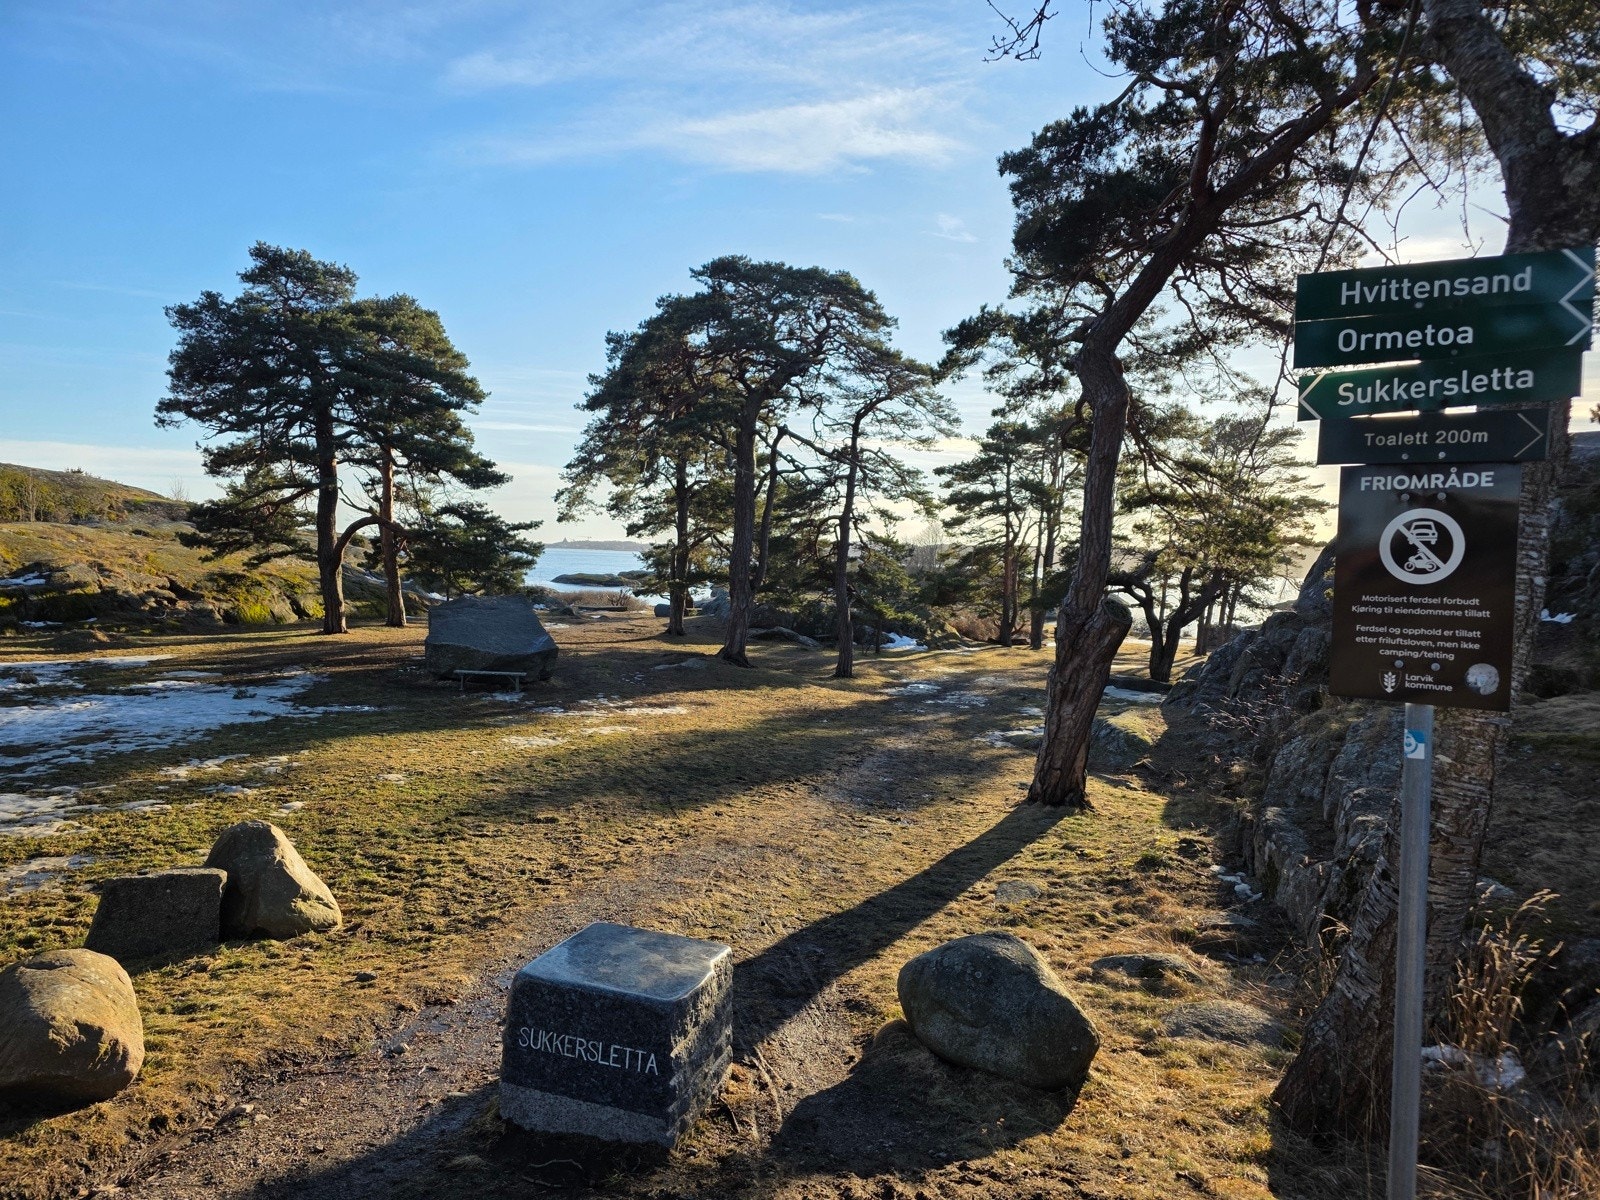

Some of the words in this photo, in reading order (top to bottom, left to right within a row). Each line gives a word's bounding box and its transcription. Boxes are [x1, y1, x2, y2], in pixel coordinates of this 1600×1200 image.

[1340, 266, 1532, 306] Hvittensand
[1337, 324, 1474, 352] Ormetoa
[1337, 367, 1535, 406] Sukkersletta
[1364, 431, 1428, 446] Toalett
[1435, 429, 1489, 444] 200m
[1360, 466, 1495, 491] FRIOMRÅDE
[1361, 595, 1408, 604] Motorisert
[1409, 596, 1441, 604] ferdsel
[1443, 596, 1480, 606] forbudt
[1351, 605, 1383, 615] Kjøring
[1384, 605, 1393, 614] til
[1394, 607, 1463, 617] eiendommene
[1464, 608, 1491, 618] tillatt
[1356, 624, 1387, 633] Ferdsel
[1388, 627, 1401, 635] og
[1402, 626, 1442, 636] opphold
[1443, 629, 1453, 637] er
[1455, 629, 1482, 638] tillatt
[1355, 636, 1377, 644] etter
[1378, 636, 1436, 648] friluftsloven,
[1437, 641, 1459, 649] men
[1460, 641, 1481, 650] ikke
[1379, 649, 1455, 661] camping/telting
[1405, 673, 1434, 682] Larvik
[1404, 681, 1453, 692] kommune
[518, 1027, 659, 1076] SUKKERSLETTA
